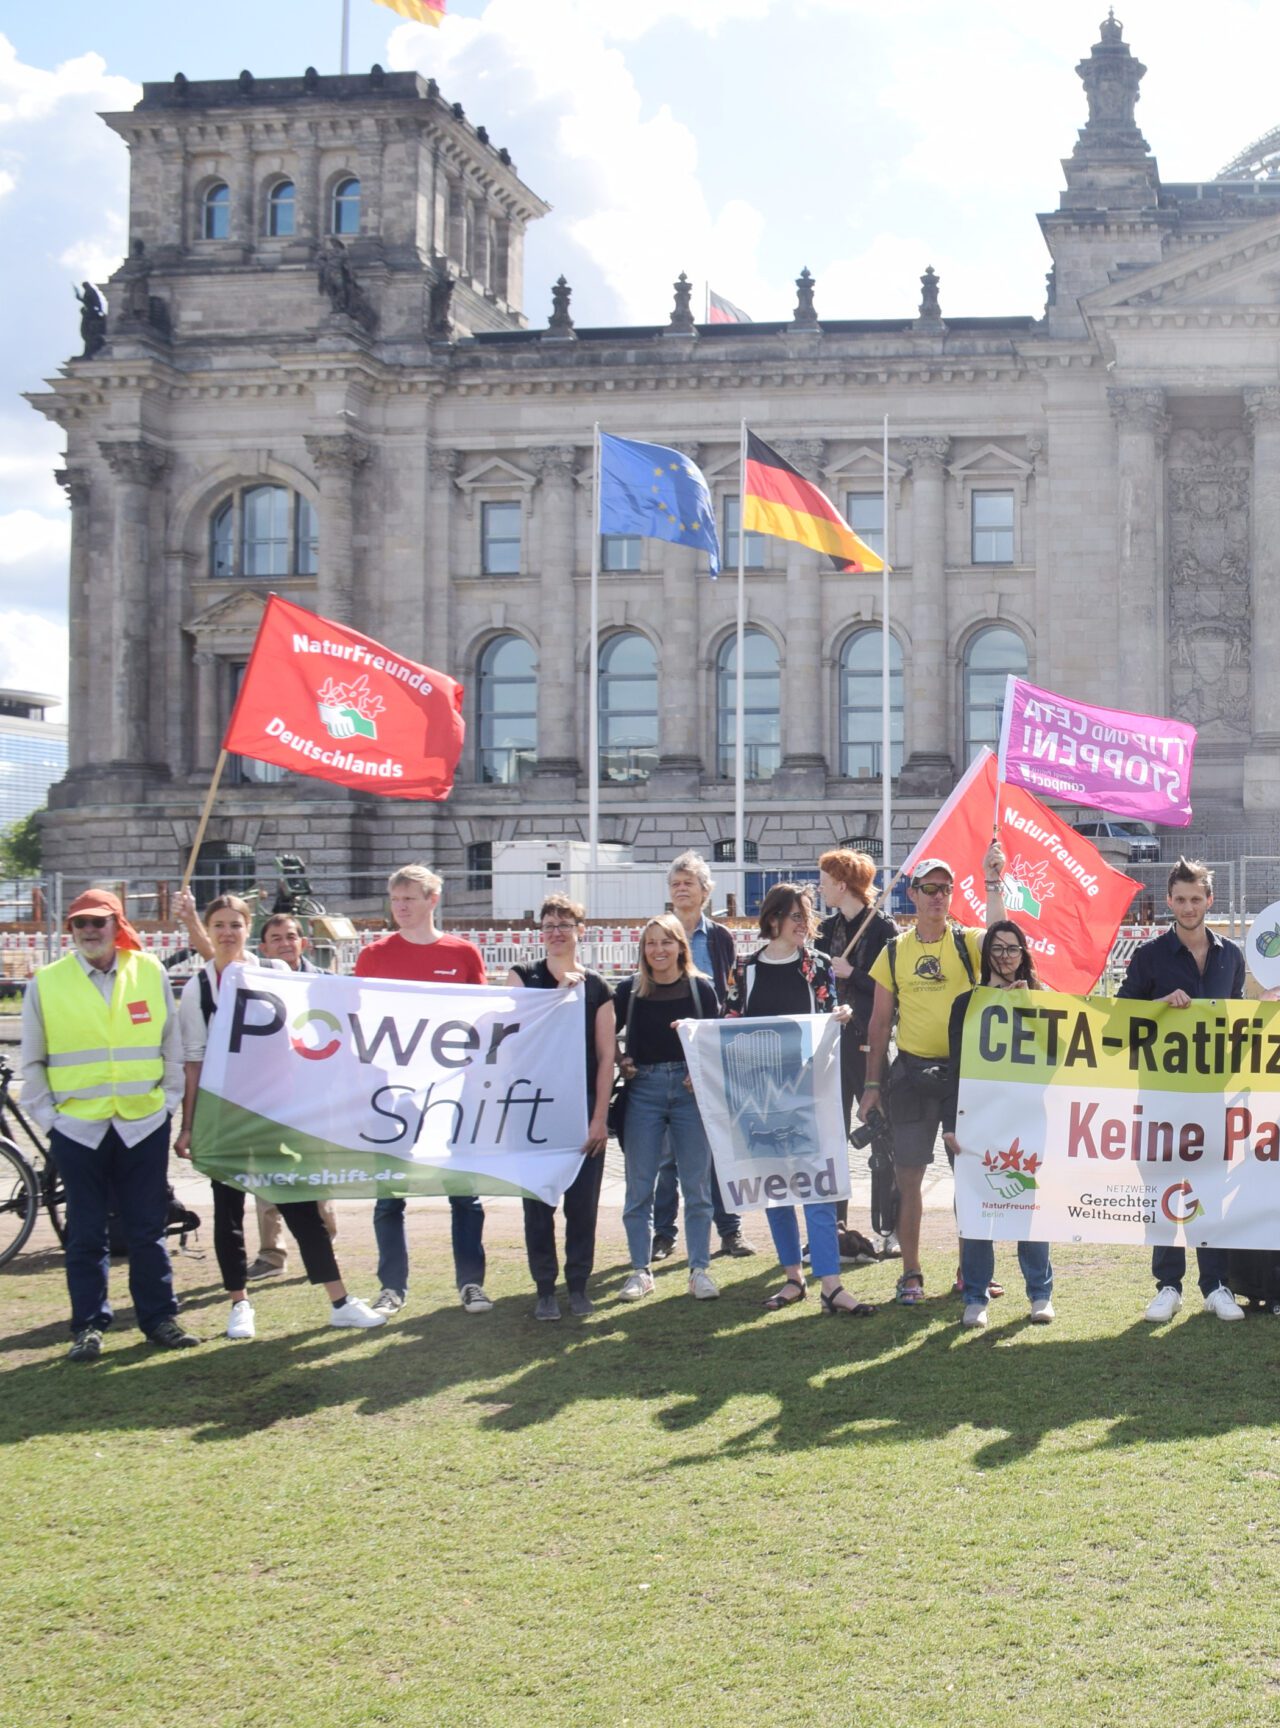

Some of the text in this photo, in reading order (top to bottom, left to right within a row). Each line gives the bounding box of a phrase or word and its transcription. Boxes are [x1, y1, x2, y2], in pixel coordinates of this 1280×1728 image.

[292, 634, 433, 696] NaturFreunde
[264, 717, 404, 778] Deutschlands
[1004, 807, 1100, 897] NaturFreunde
[959, 875, 1057, 956] Deutsnds
[228, 987, 520, 1068] Power
[359, 1079, 555, 1145] Shift
[1067, 1101, 1205, 1162] Keine
[727, 1157, 839, 1207] weed
[982, 1202, 1041, 1211] NaturFreunde
[1080, 1194, 1158, 1208] Gerechter
[1106, 1184, 1158, 1193] NETZWERK
[982, 1210, 1004, 1218] Berlin
[1067, 1206, 1157, 1224] Welthandel
